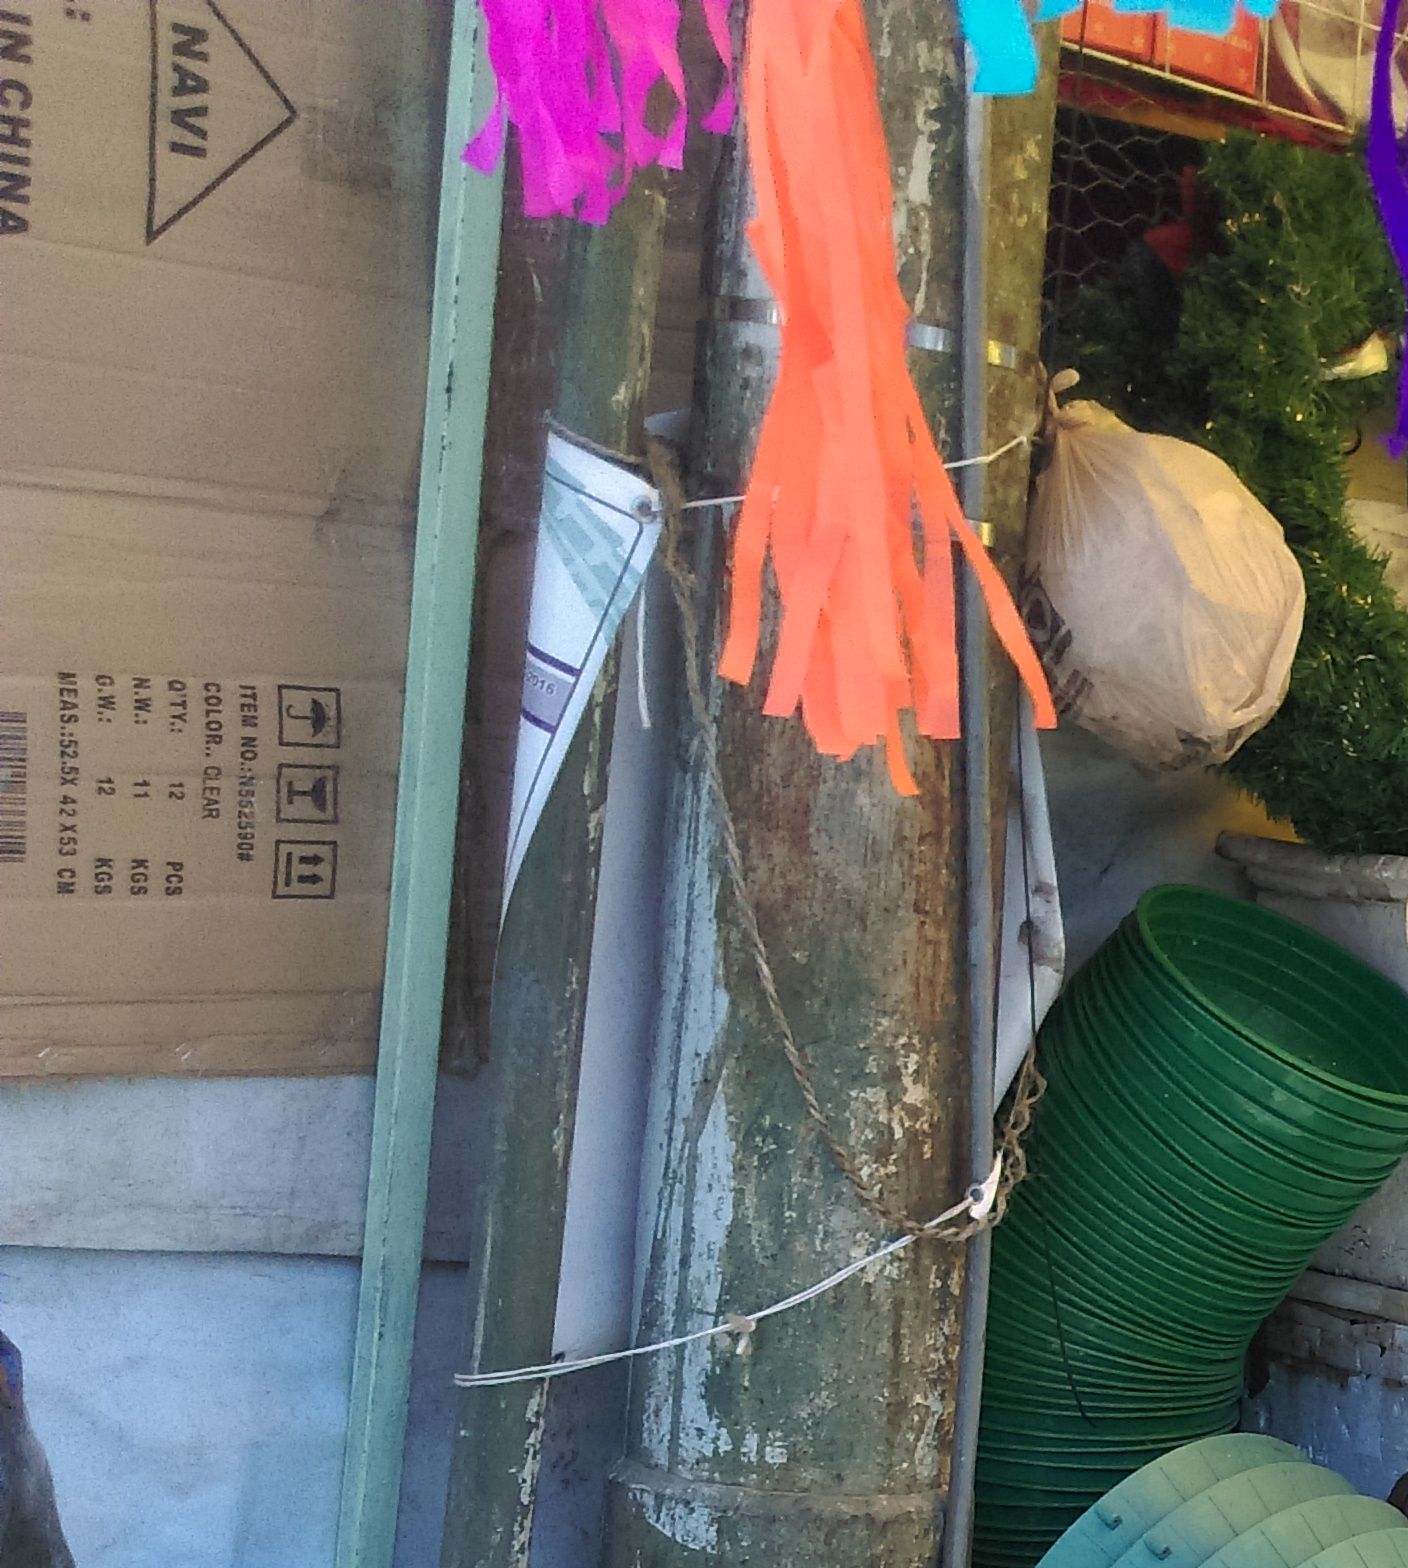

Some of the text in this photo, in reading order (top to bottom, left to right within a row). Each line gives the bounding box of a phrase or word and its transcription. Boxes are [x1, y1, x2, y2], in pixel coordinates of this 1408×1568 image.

[170, 22, 209, 159] NAVI
[526, 671, 556, 696] 2016
[239, 684, 258, 732] ITEM
[94, 674, 116, 896] G.W.: 12 KGS
[130, 677, 151, 896] N.W.: 11 KGS
[168, 782, 185, 801] 12
[202, 766, 222, 820] CLEAR
[57, 867, 76, 896] CM
[165, 861, 184, 897] PCS
